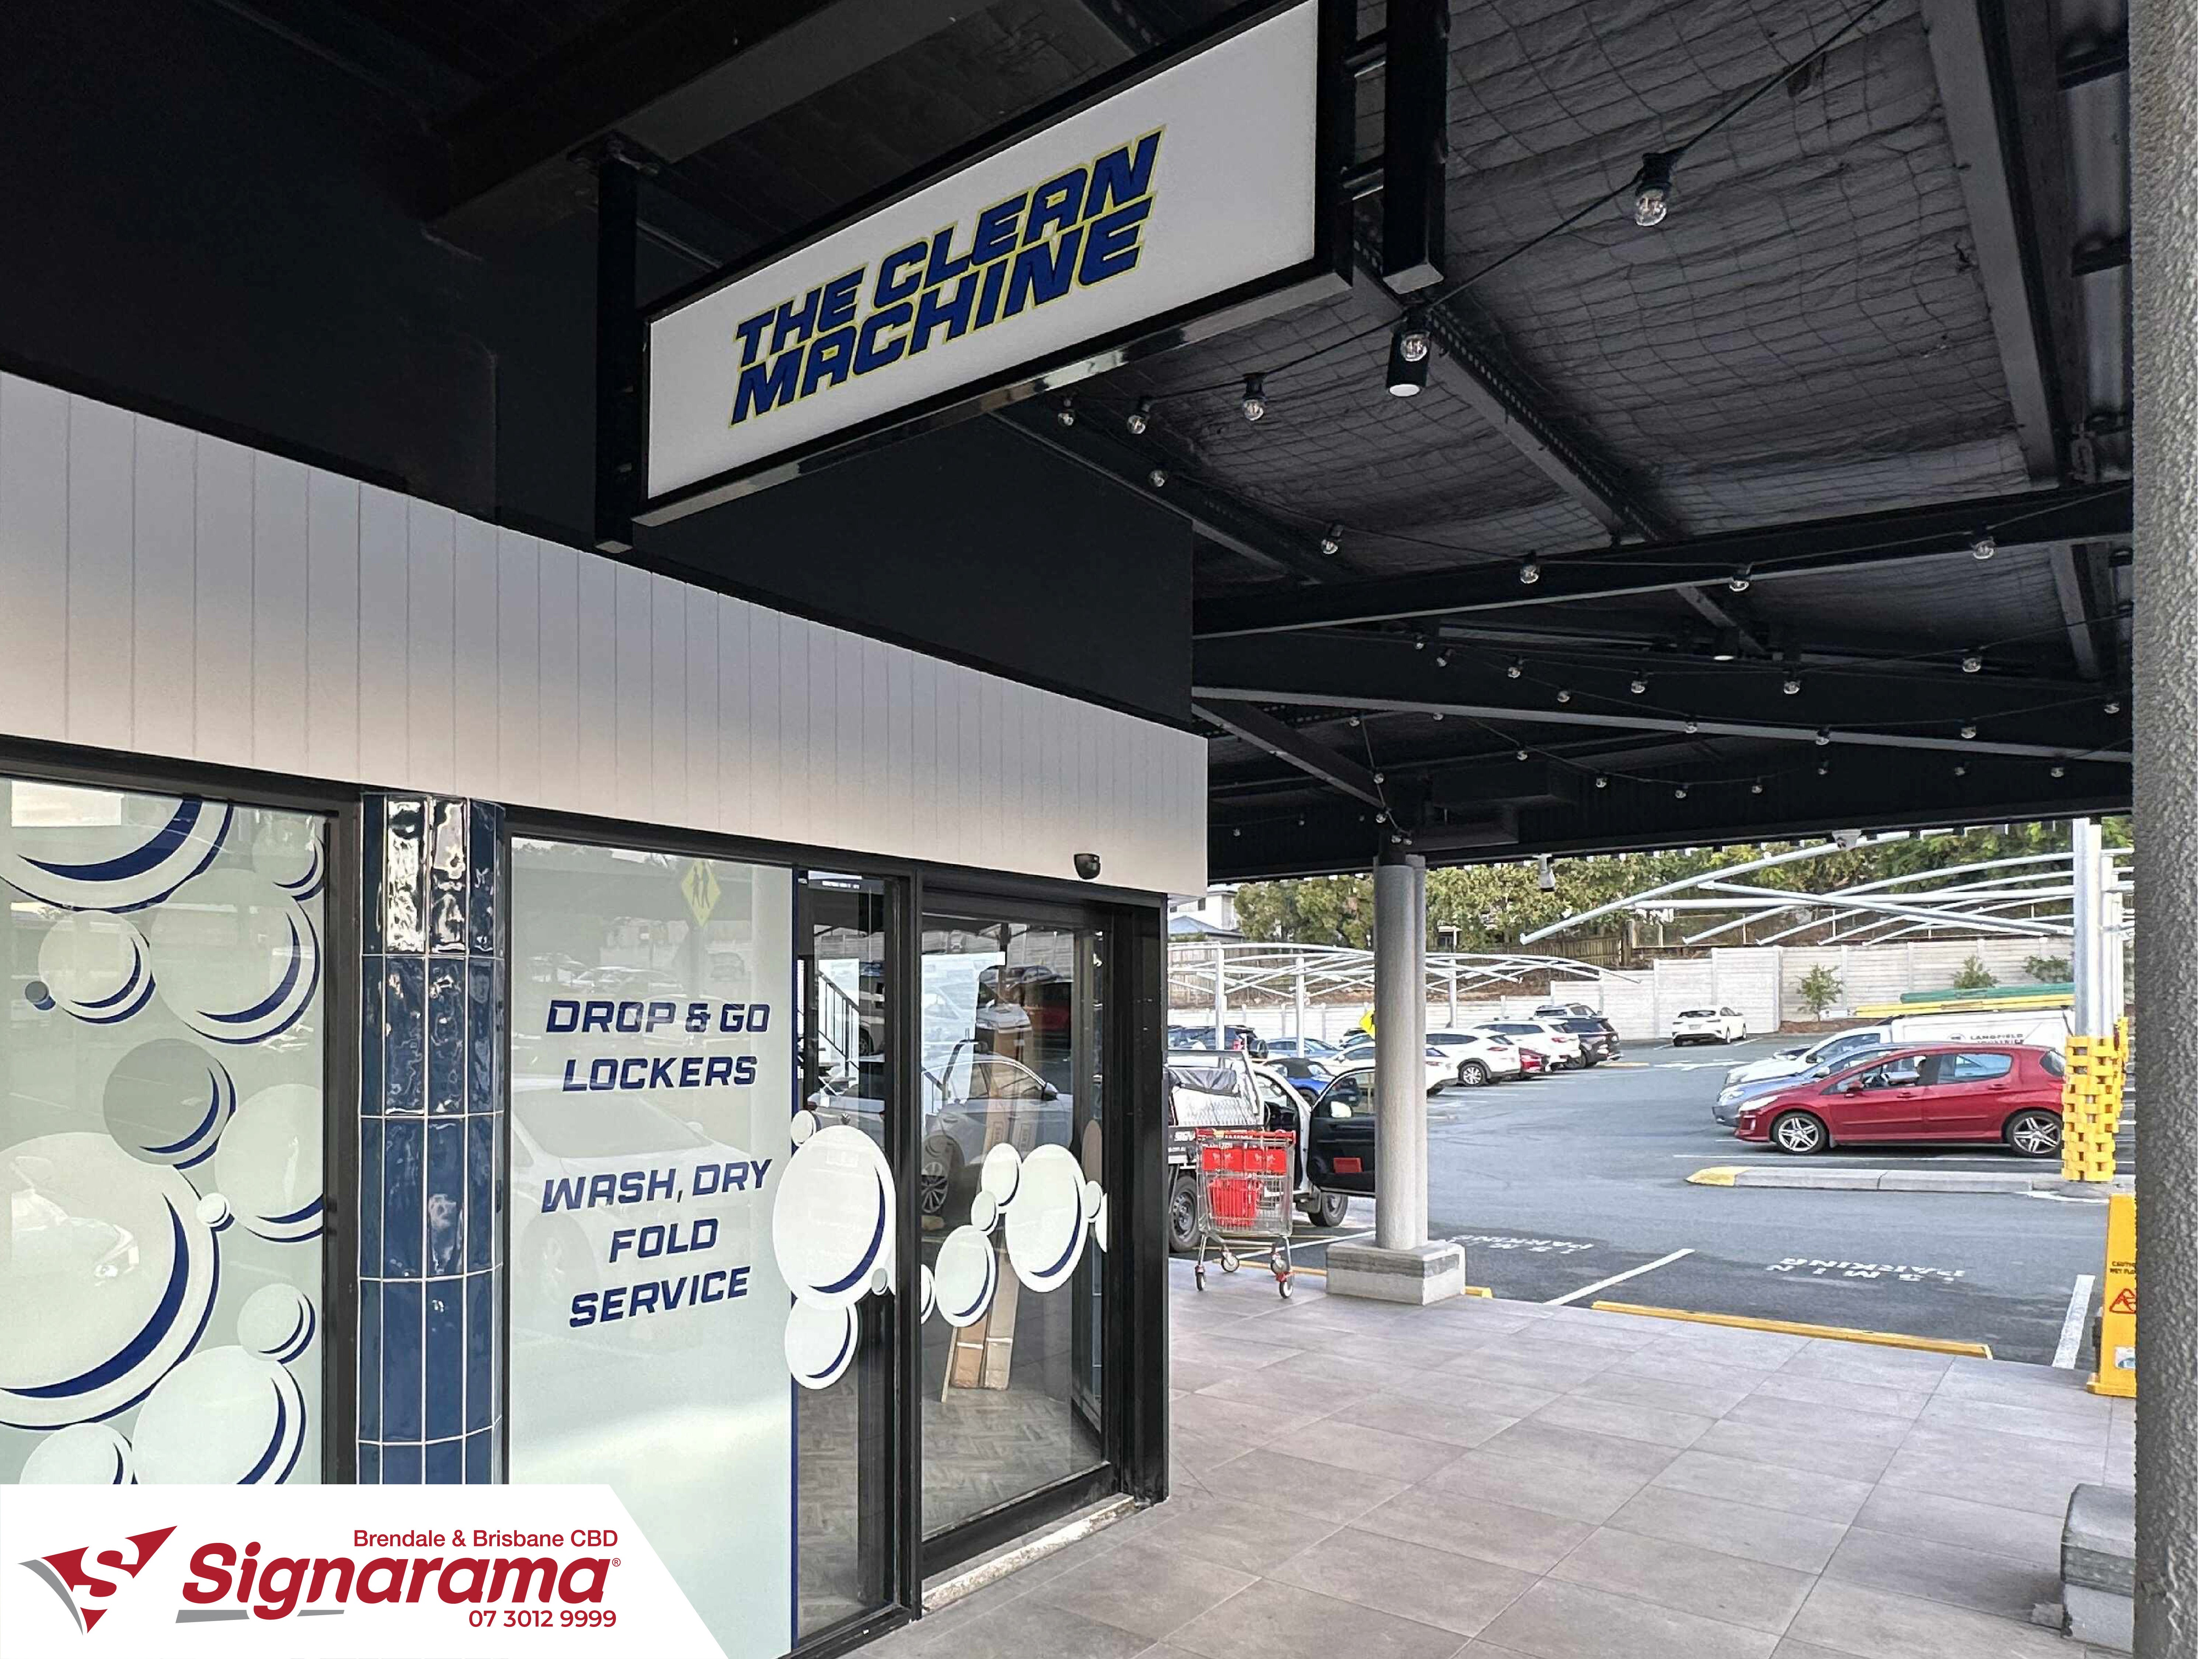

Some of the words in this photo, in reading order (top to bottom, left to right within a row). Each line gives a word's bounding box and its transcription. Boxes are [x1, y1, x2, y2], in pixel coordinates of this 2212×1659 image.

[733, 263, 868, 368] THE
[872, 125, 1165, 309] CLEAN
[729, 193, 1156, 428] MACHINE
[546, 1000, 676, 1032] DROP
[686, 1003, 711, 1032] &
[720, 1004, 771, 1032] GO
[562, 1056, 758, 1091] LOCKERS
[541, 1168, 683, 1213] WASH,
[692, 1158, 773, 1196] DRY
[609, 1218, 719, 1263] FOLD
[1779, 1258, 1966, 1277] PARKING
[569, 1266, 751, 1328] SERVICE
